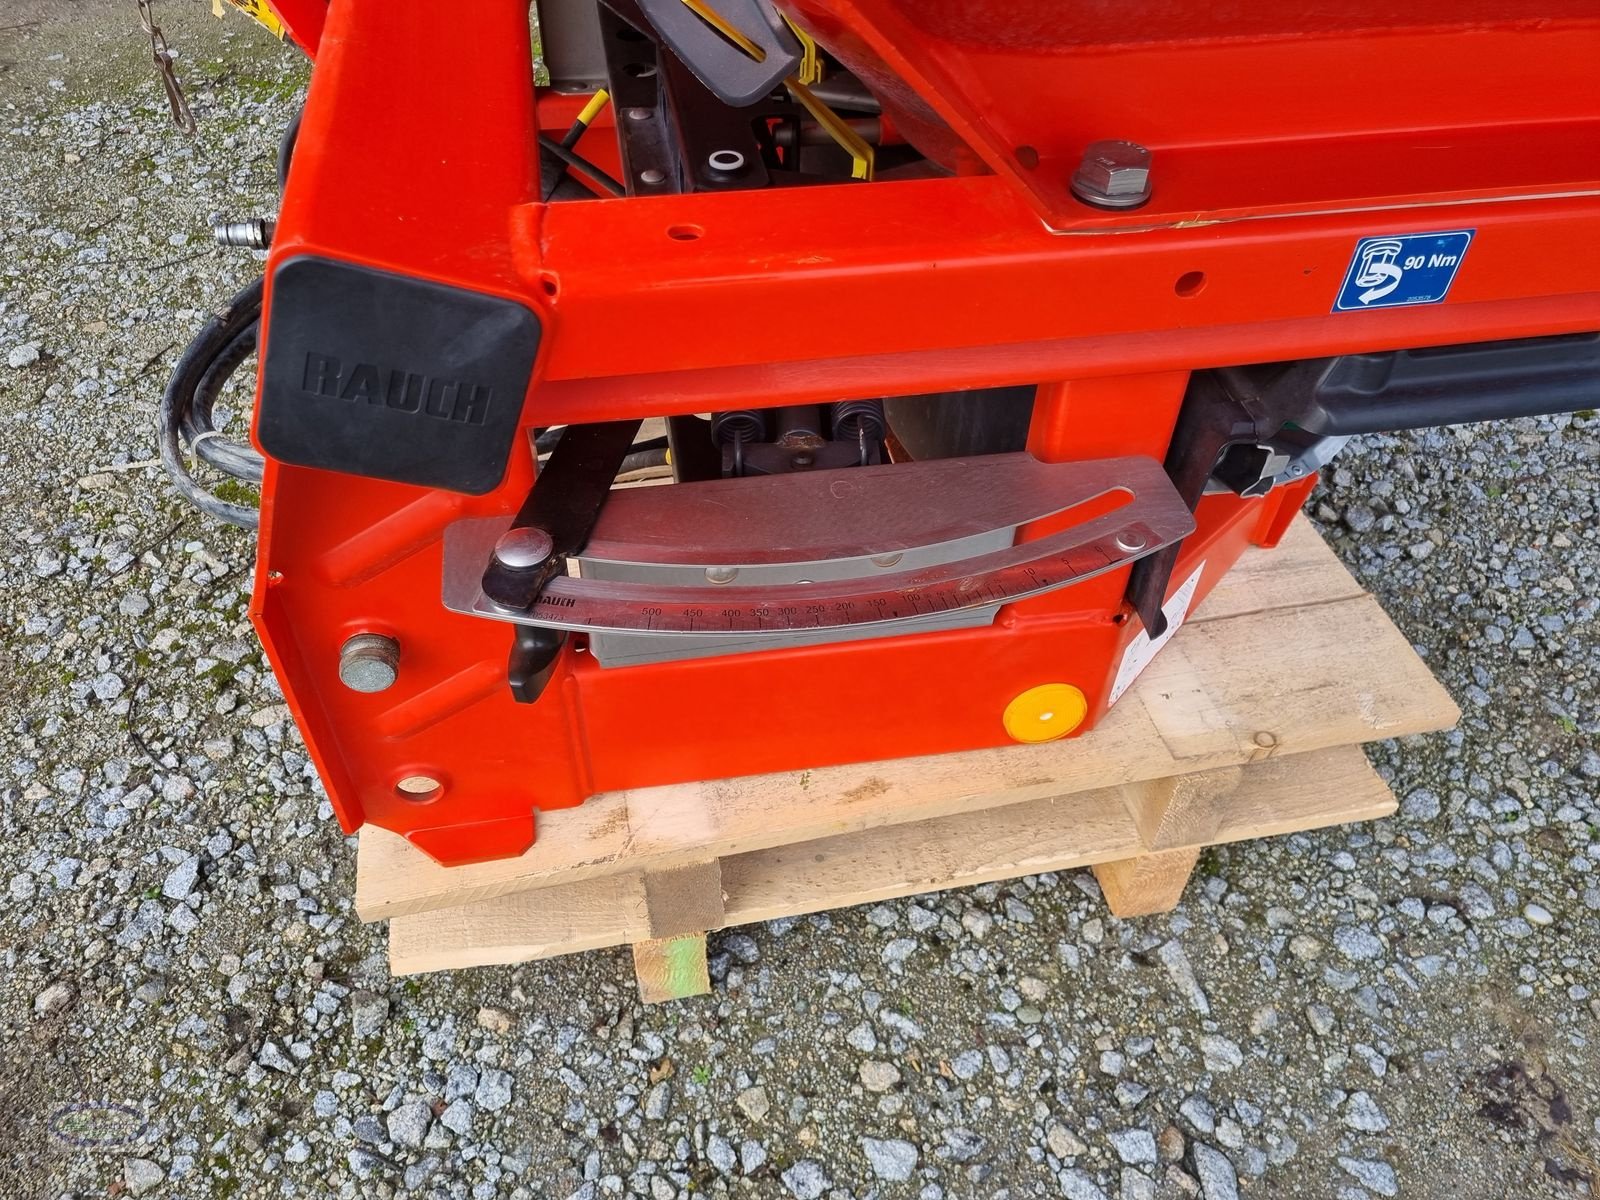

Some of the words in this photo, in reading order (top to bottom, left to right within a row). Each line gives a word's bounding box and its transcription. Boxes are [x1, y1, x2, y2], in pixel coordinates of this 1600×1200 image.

[1403, 255, 1425, 270] 90
[1427, 254, 1457, 268] Nm
[302, 351, 493, 426] RAUCH
[641, 607, 662, 616] 500
[683, 608, 703, 617] 450
[721, 609, 741, 617] 400
[750, 608, 769, 617] 350
[778, 607, 797, 616] 300
[806, 605, 825, 614] 250
[836, 602, 855, 611] 200
[868, 598, 887, 608] 150
[902, 593, 921, 602] 100
[1023, 567, 1036, 577] 10
